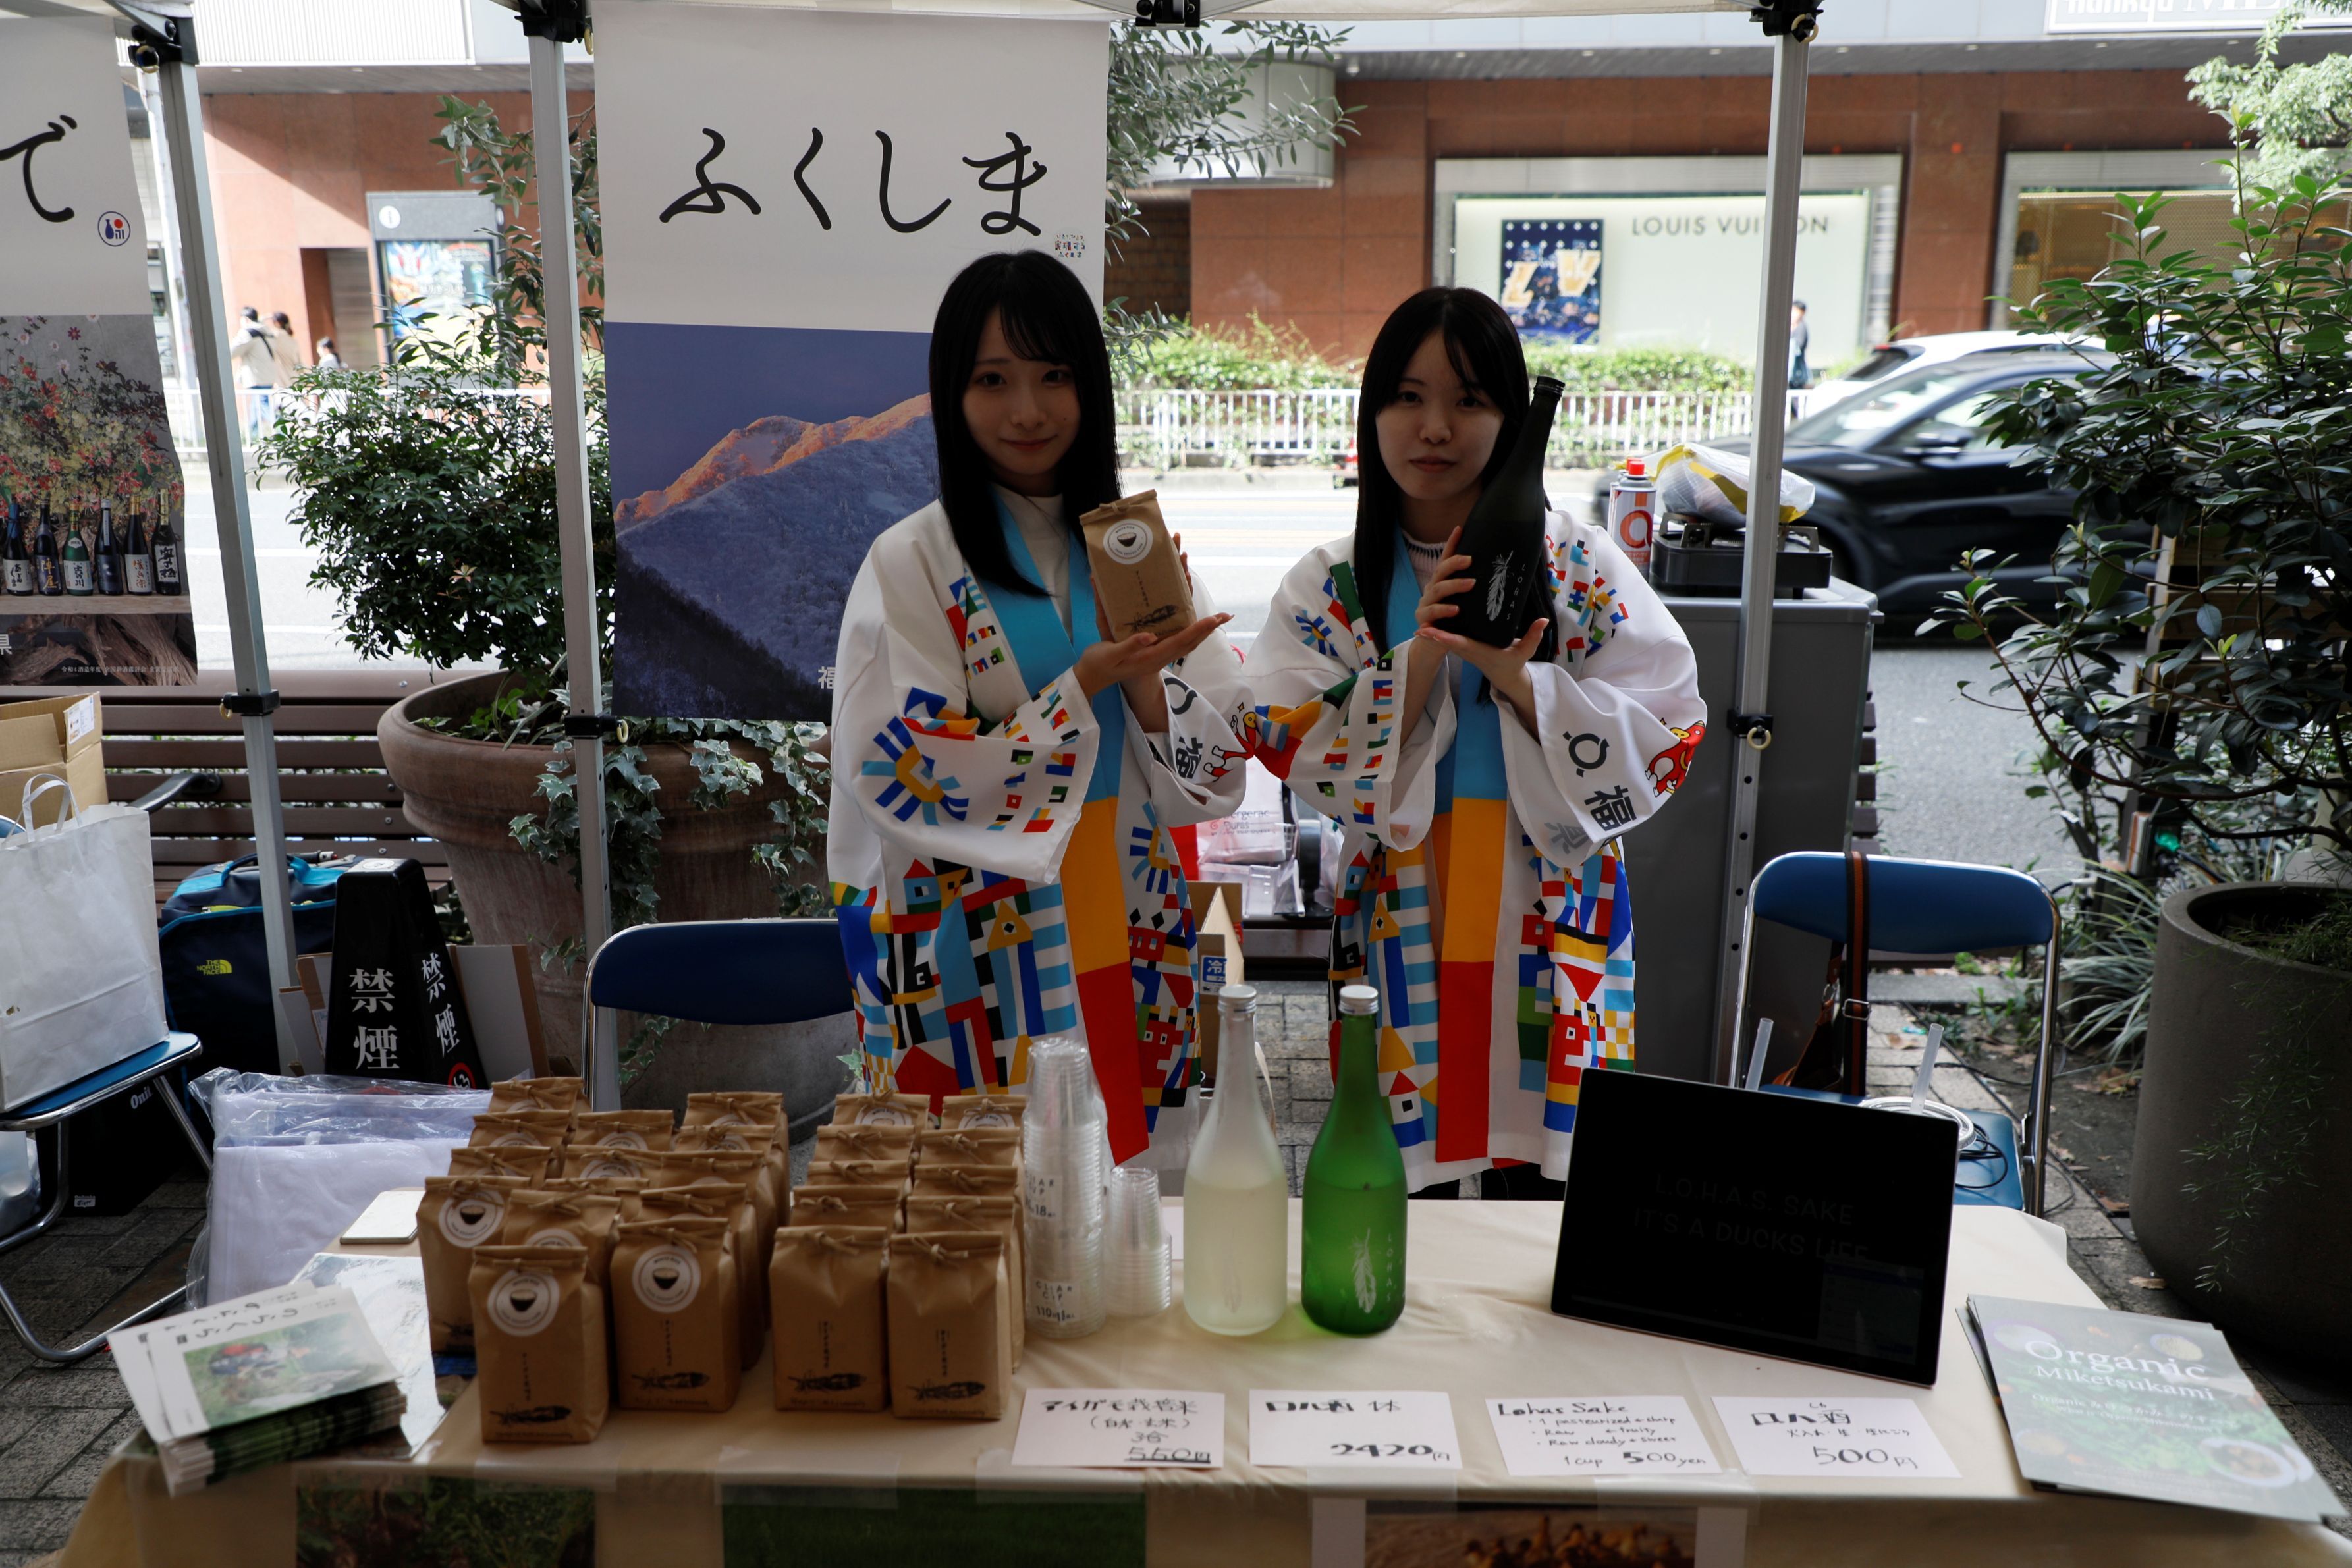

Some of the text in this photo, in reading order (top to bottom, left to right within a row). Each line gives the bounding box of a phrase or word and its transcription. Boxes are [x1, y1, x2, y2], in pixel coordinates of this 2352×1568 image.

[659, 127, 1047, 237] ふくしま
[1631, 214, 1830, 236] LOUIS VUION
[41, 558, 59, 591] 陣屋
[158, 547, 177, 579] 奥の松
[1507, 564, 1526, 620] LOHAS
[1226, 809, 1271, 819] ergerac
[1584, 784, 1637, 831] 福
[349, 968, 400, 1070] 禁煙
[422, 952, 460, 1058] 禁煙
[1783, 1194, 1854, 1226] SAKE
[1688, 1220, 1705, 1239] A
[1715, 1222, 1805, 1257] DUCKS
[2024, 1339, 2210, 1381] Organic
[2036, 1363, 2215, 1402] Miketsukami
[1498, 1401, 1629, 1416] Lohas Sake
[1555, 1416, 1631, 1427] pasteurized
[1330, 1443, 1450, 1461] 2420円
[1585, 1436, 1626, 1447] cloudy
[1574, 1457, 1604, 1467] cup
[1813, 1446, 1919, 1470] 500円
